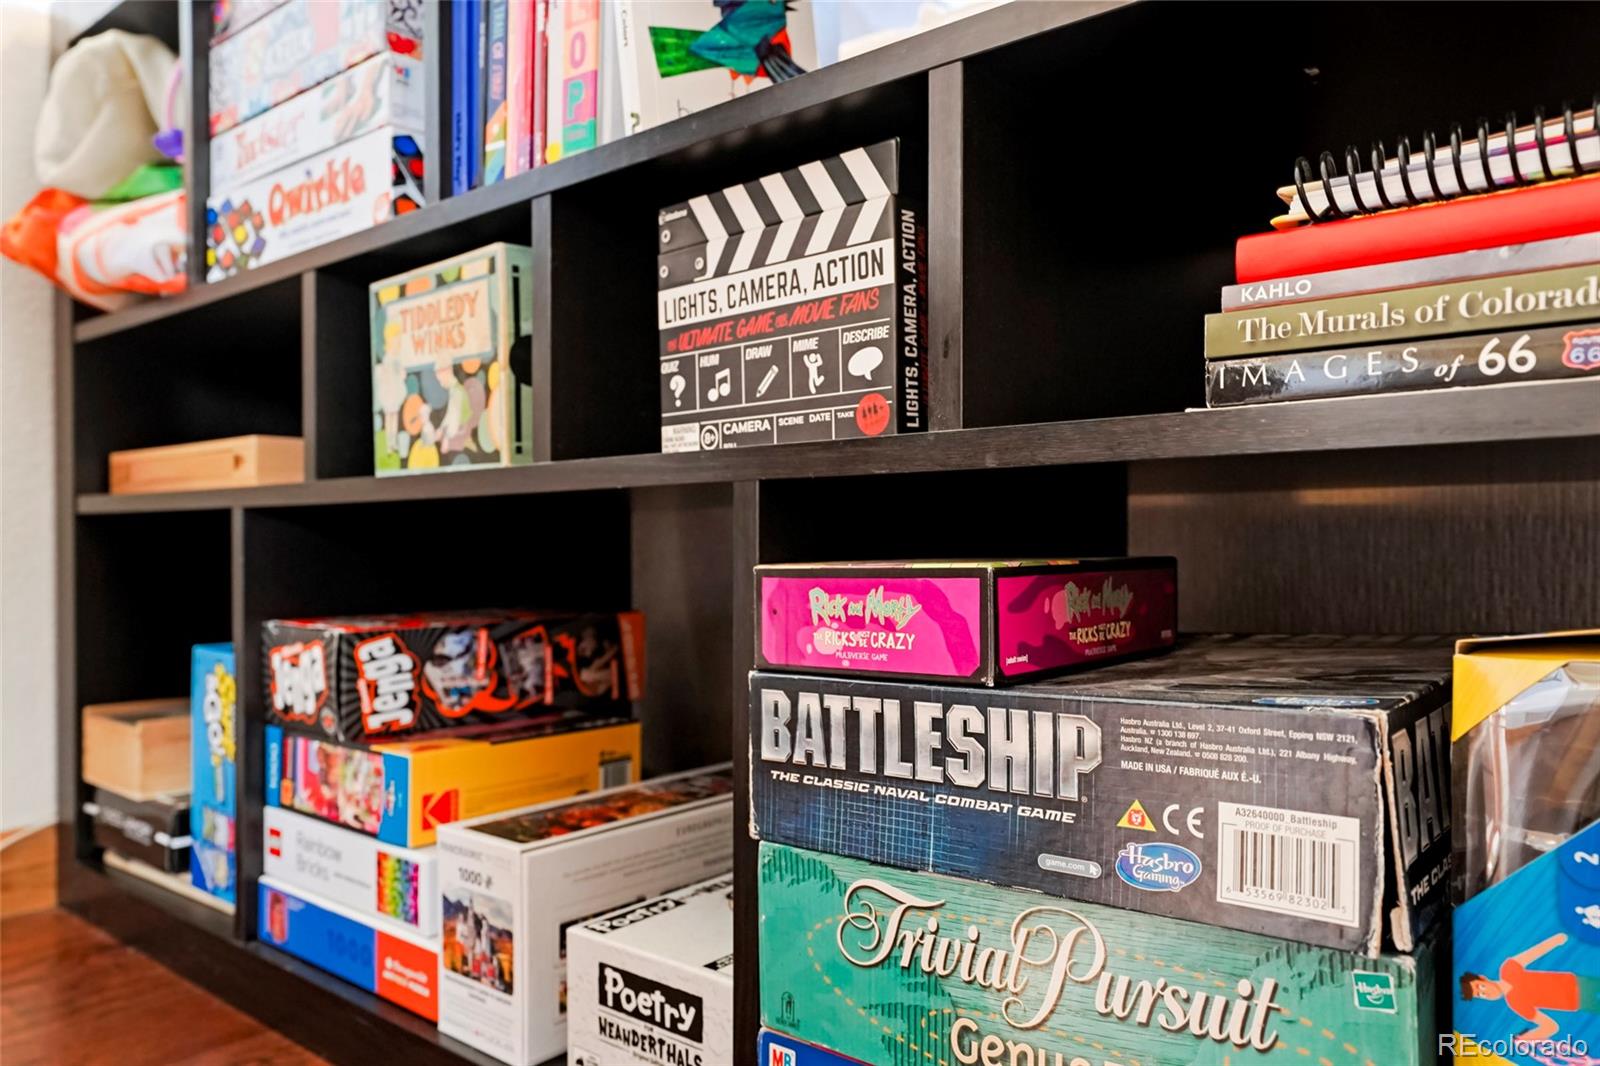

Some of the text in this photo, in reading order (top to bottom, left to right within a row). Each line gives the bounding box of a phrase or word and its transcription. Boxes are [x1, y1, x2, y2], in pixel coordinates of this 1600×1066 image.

[268, 157, 365, 228] Qwirkle
[664, 247, 884, 324] LIGHTS, CAMERA, ACTION
[1240, 279, 1312, 303] KAHLO
[678, 320, 734, 351] ULTIMATE
[736, 311, 776, 339] GAME
[789, 296, 837, 327] MOVIE
[839, 287, 880, 316] FANS
[901, 209, 919, 428] LIGHTS, CAMERA, ACTION
[1237, 275, 1600, 343] The Murals of Colorad
[411, 322, 466, 354] WINKS
[793, 337, 819, 353] MIME
[842, 325, 890, 345] DESCRIBE
[745, 345, 772, 361] DRAW
[1219, 334, 1537, 389] IMAGES of 66
[1570, 346, 1600, 364] 66
[778, 412, 831, 427] SCENE DATE
[836, 411, 855, 419] TAKE
[704, 432, 716, 445] 8+
[723, 419, 771, 435] CAMERA
[825, 631, 857, 648] RICKS
[870, 632, 916, 650] CRAZY
[1076, 626, 1098, 644] RICKS
[1106, 621, 1131, 640] CRAZY
[871, 653, 888, 662] GAME
[358, 637, 415, 730] Jenga
[1120, 717, 1141, 726] Hasbro
[1143, 719, 1170, 728] Australia
[1188, 722, 1205, 731] Level
[1216, 724, 1235, 733] 37-41
[1239, 726, 1261, 735] Oxford
[1263, 728, 1287, 738] Street,
[1289, 730, 1314, 741] Epping
[1316, 732, 1334, 741] NSW
[1336, 734, 1358, 744] 2121,
[1158, 729, 1173, 738] 1300
[1174, 731, 1186, 739] 138
[761, 688, 1102, 801] BATTLESHIP
[1120, 744, 1149, 754] Auckland,
[1151, 747, 1164, 755] New
[1120, 735, 1142, 744] Hasbro
[1144, 737, 1153, 745] NZ
[1156, 738, 1162, 747] (a
[1165, 739, 1187, 748] branch
[1190, 741, 1197, 749] of
[1200, 742, 1223, 751] Hasbro
[1225, 744, 1255, 754] Australia
[1279, 749, 1292, 758] 221
[1295, 751, 1320, 762] Albany
[1324, 753, 1357, 765] Highway,
[1121, 760, 1144, 771] MADE
[1145, 763, 1154, 772] IN
[1155, 764, 1171, 774] USA
[1179, 766, 1220, 779] FABRIQUÉ
[1221, 771, 1239, 781] AUX
[770, 769, 1077, 824] THE CLASSIC NAVAL COMBAT GAME
[1245, 821, 1327, 838] PROOF OF PURCHASE
[1044, 857, 1086, 872] game.com
[1120, 845, 1194, 874] Hasbro
[1132, 864, 1180, 887] Gaming
[1245, 888, 1282, 902] 53569
[1289, 895, 1328, 911] 82302
[1411, 874, 1431, 906] THE
[836, 879, 1279, 1051] Trivial Pursuit
[604, 967, 696, 1032] Poetry
[598, 1016, 703, 1066] NEANDERTHALS
